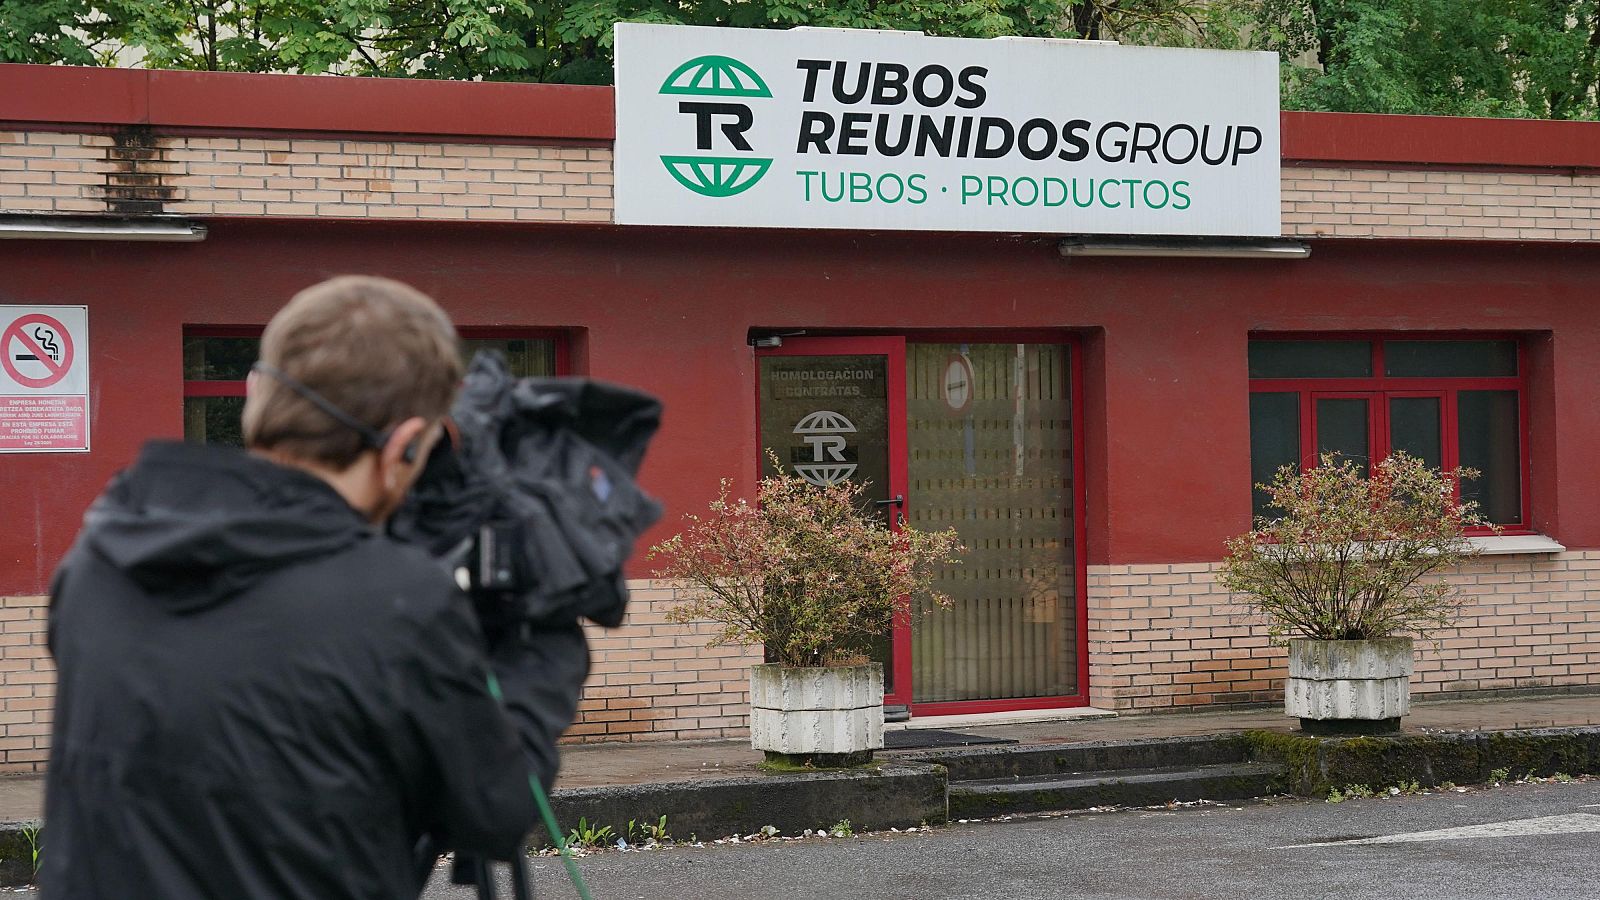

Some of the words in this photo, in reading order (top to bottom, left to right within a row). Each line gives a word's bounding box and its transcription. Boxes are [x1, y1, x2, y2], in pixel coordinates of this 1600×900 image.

[796, 58, 989, 110] TUBOS
[678, 101, 754, 152] TR
[796, 170, 928, 205] TUBOS
[961, 175, 1191, 210] PRODUCTOS
[785, 385, 861, 397] CONTRATAS
[803, 435, 847, 462] TR
